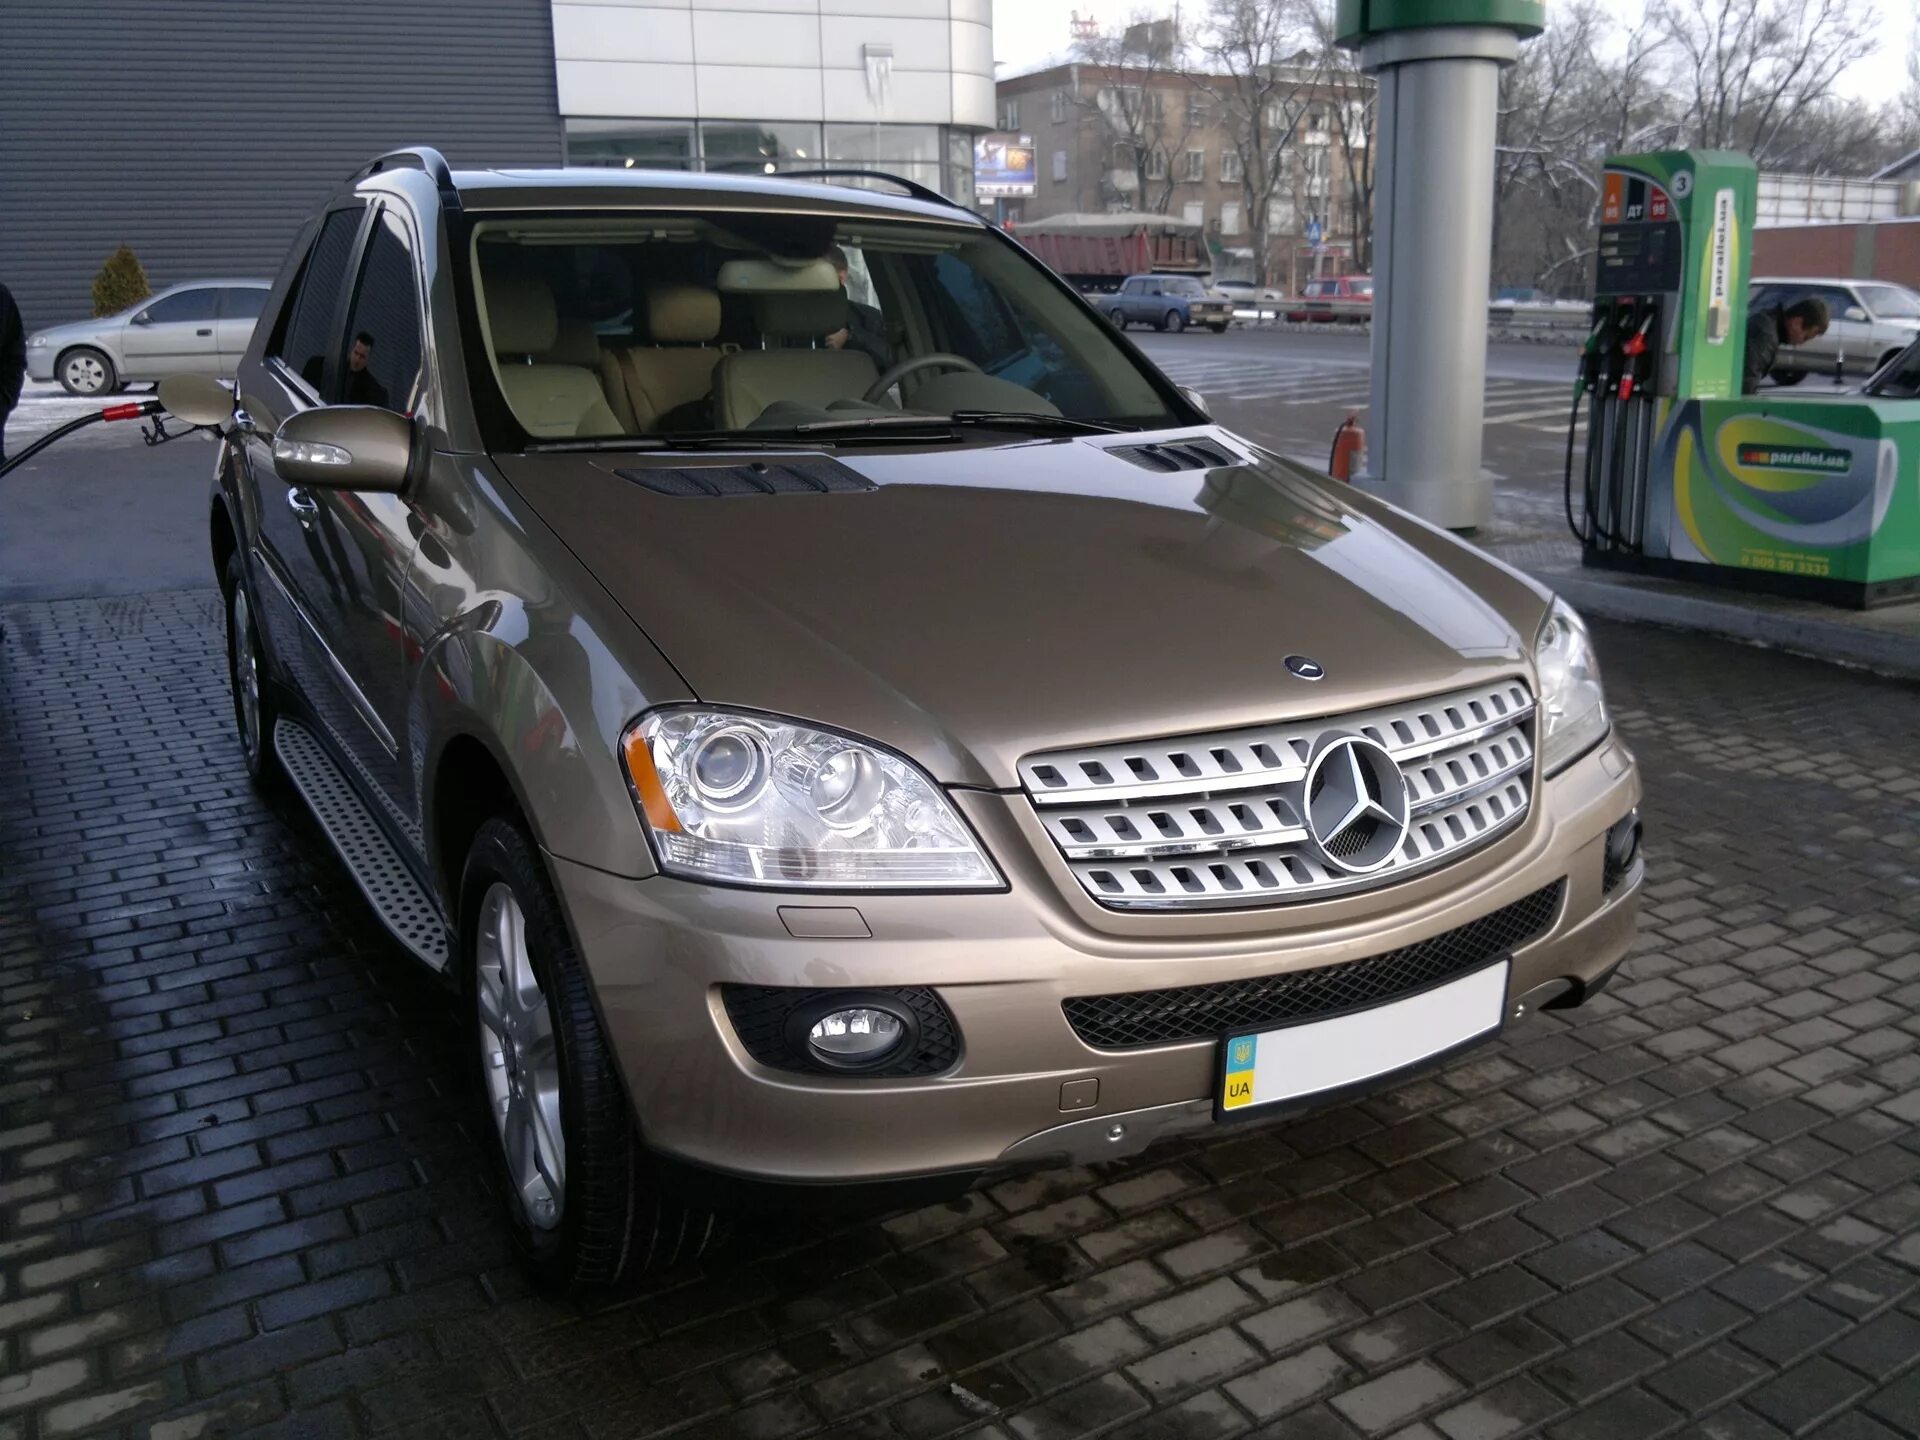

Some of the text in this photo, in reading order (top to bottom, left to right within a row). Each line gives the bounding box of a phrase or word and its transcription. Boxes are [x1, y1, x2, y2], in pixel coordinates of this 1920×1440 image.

[1676, 176, 1687, 193] 3
[1715, 199, 1728, 297] parallel.ua
[1770, 451, 1845, 468] parallel.ua
[1229, 1082, 1250, 1098] UA
